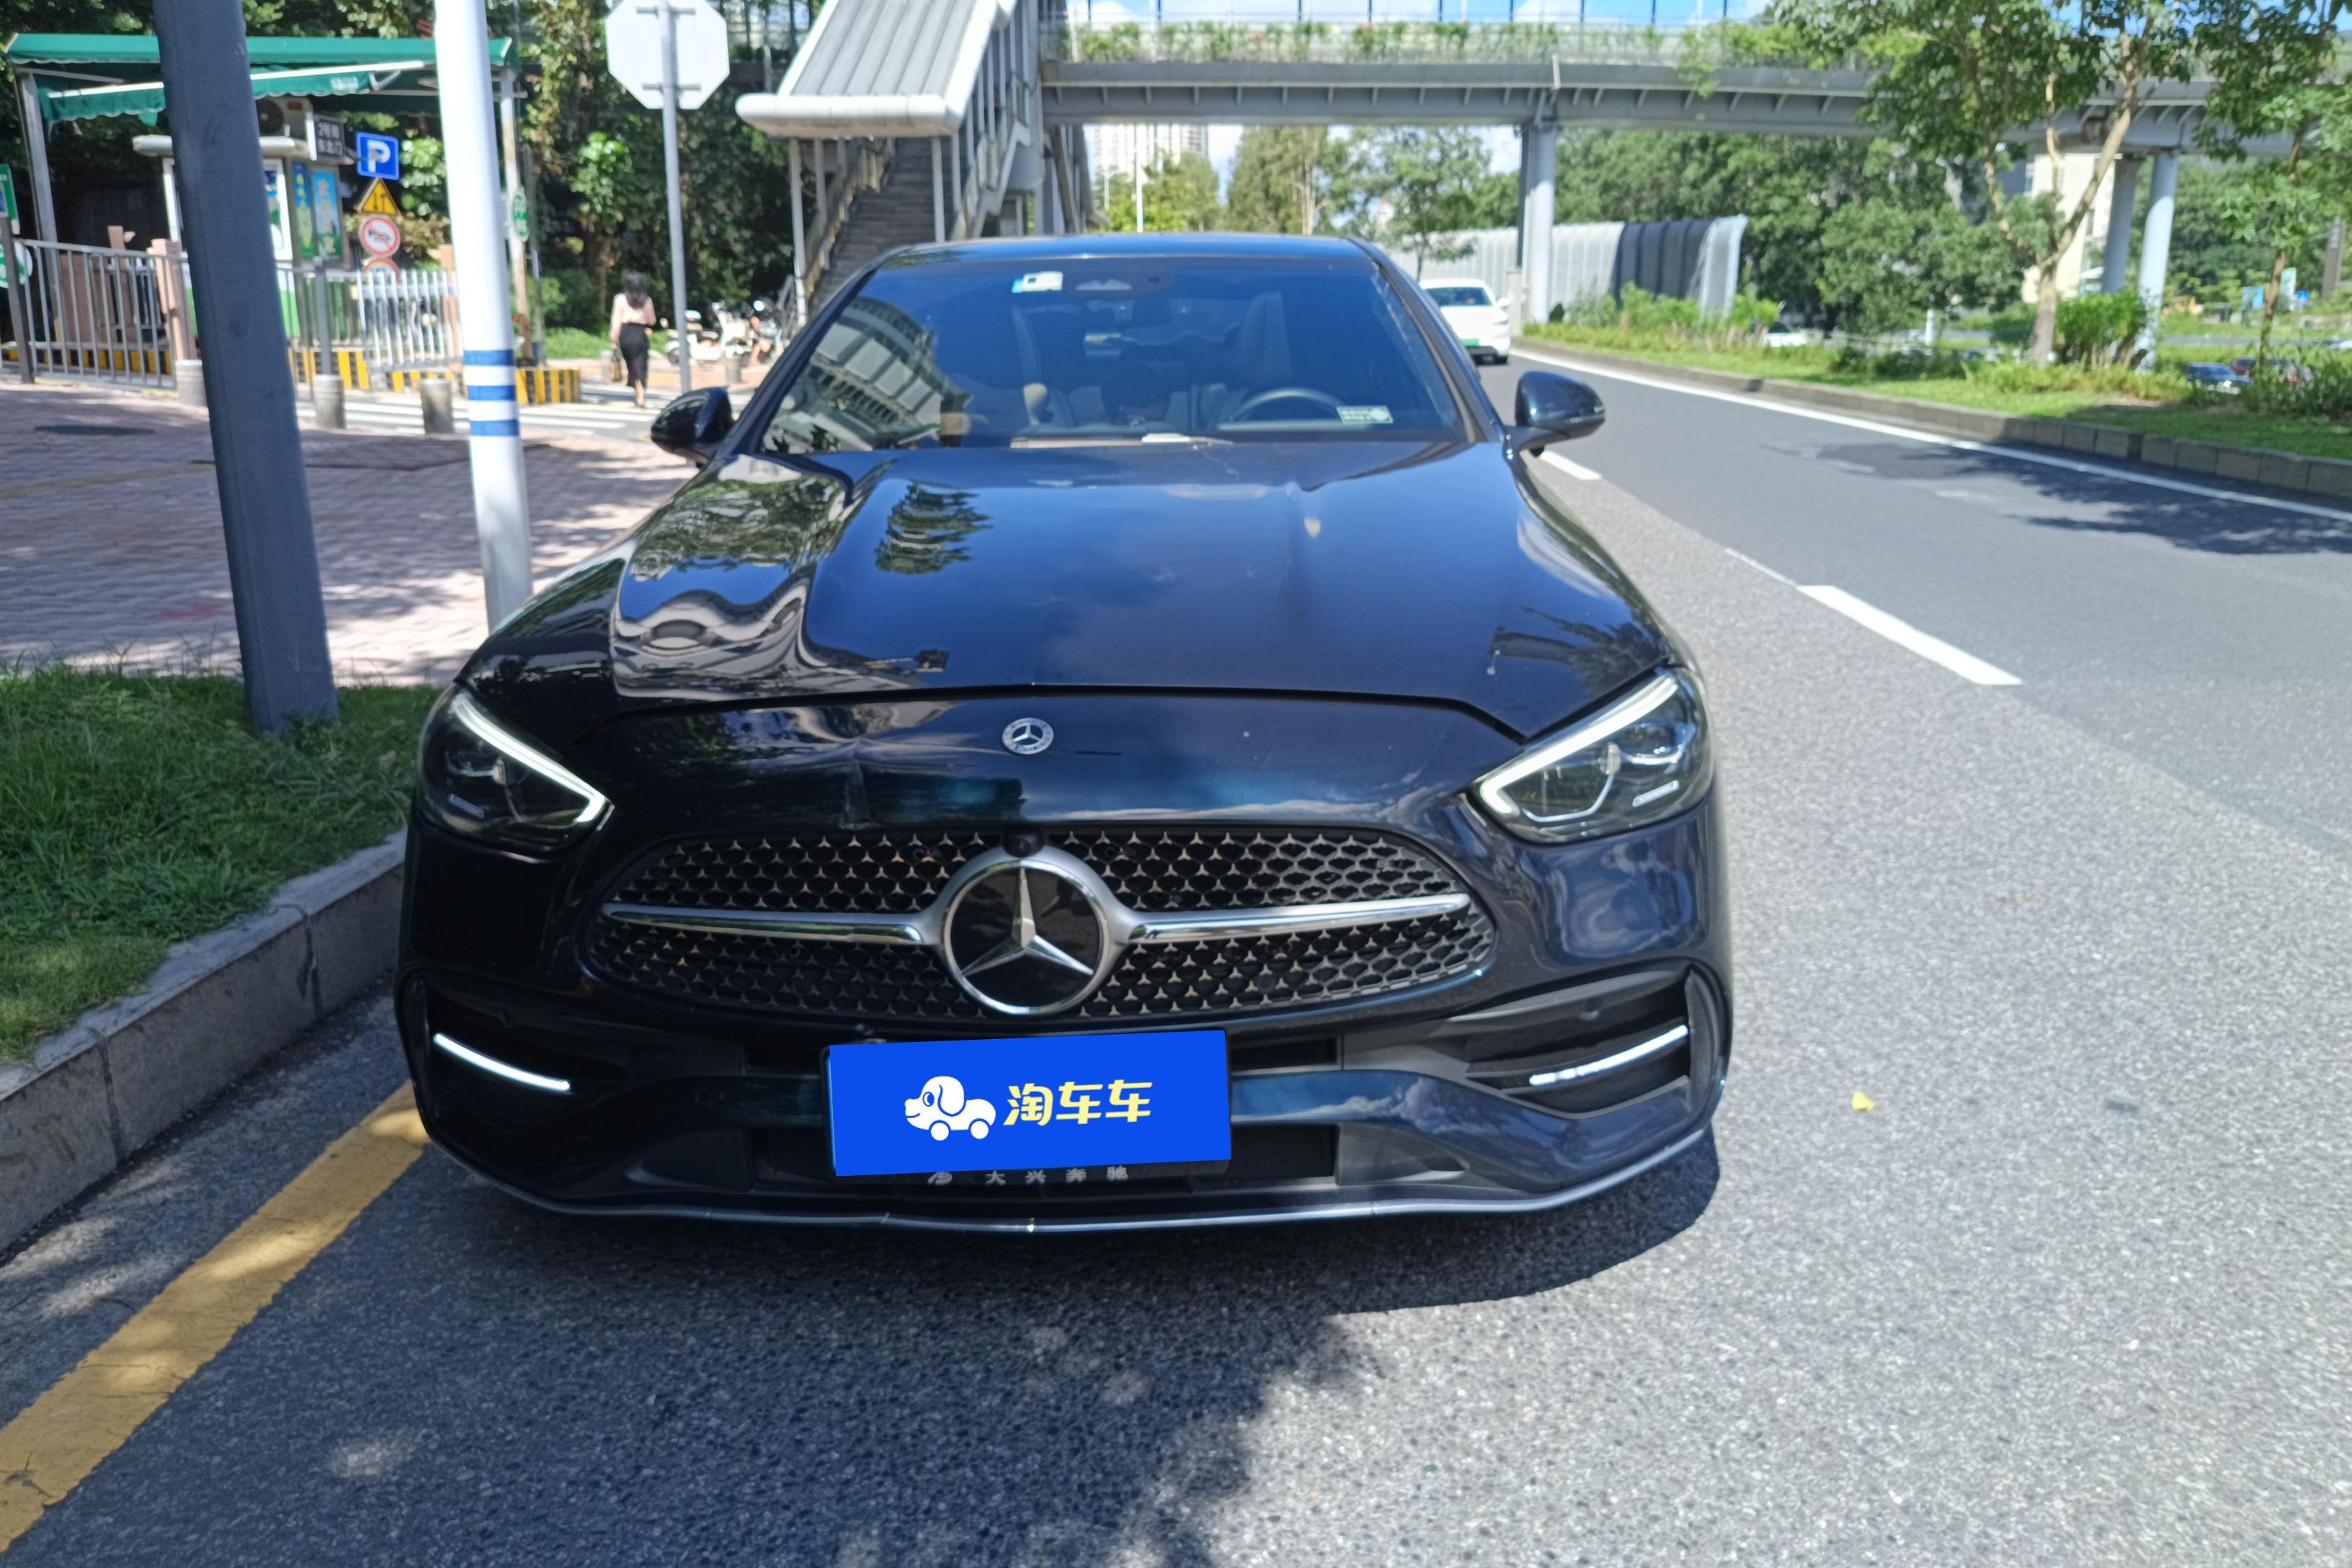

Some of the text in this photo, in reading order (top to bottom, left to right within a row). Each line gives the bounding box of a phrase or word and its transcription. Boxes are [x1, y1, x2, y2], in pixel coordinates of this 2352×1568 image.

[368, 139, 391, 173] P
[984, 1164, 1129, 1185] 大兴奔驰
